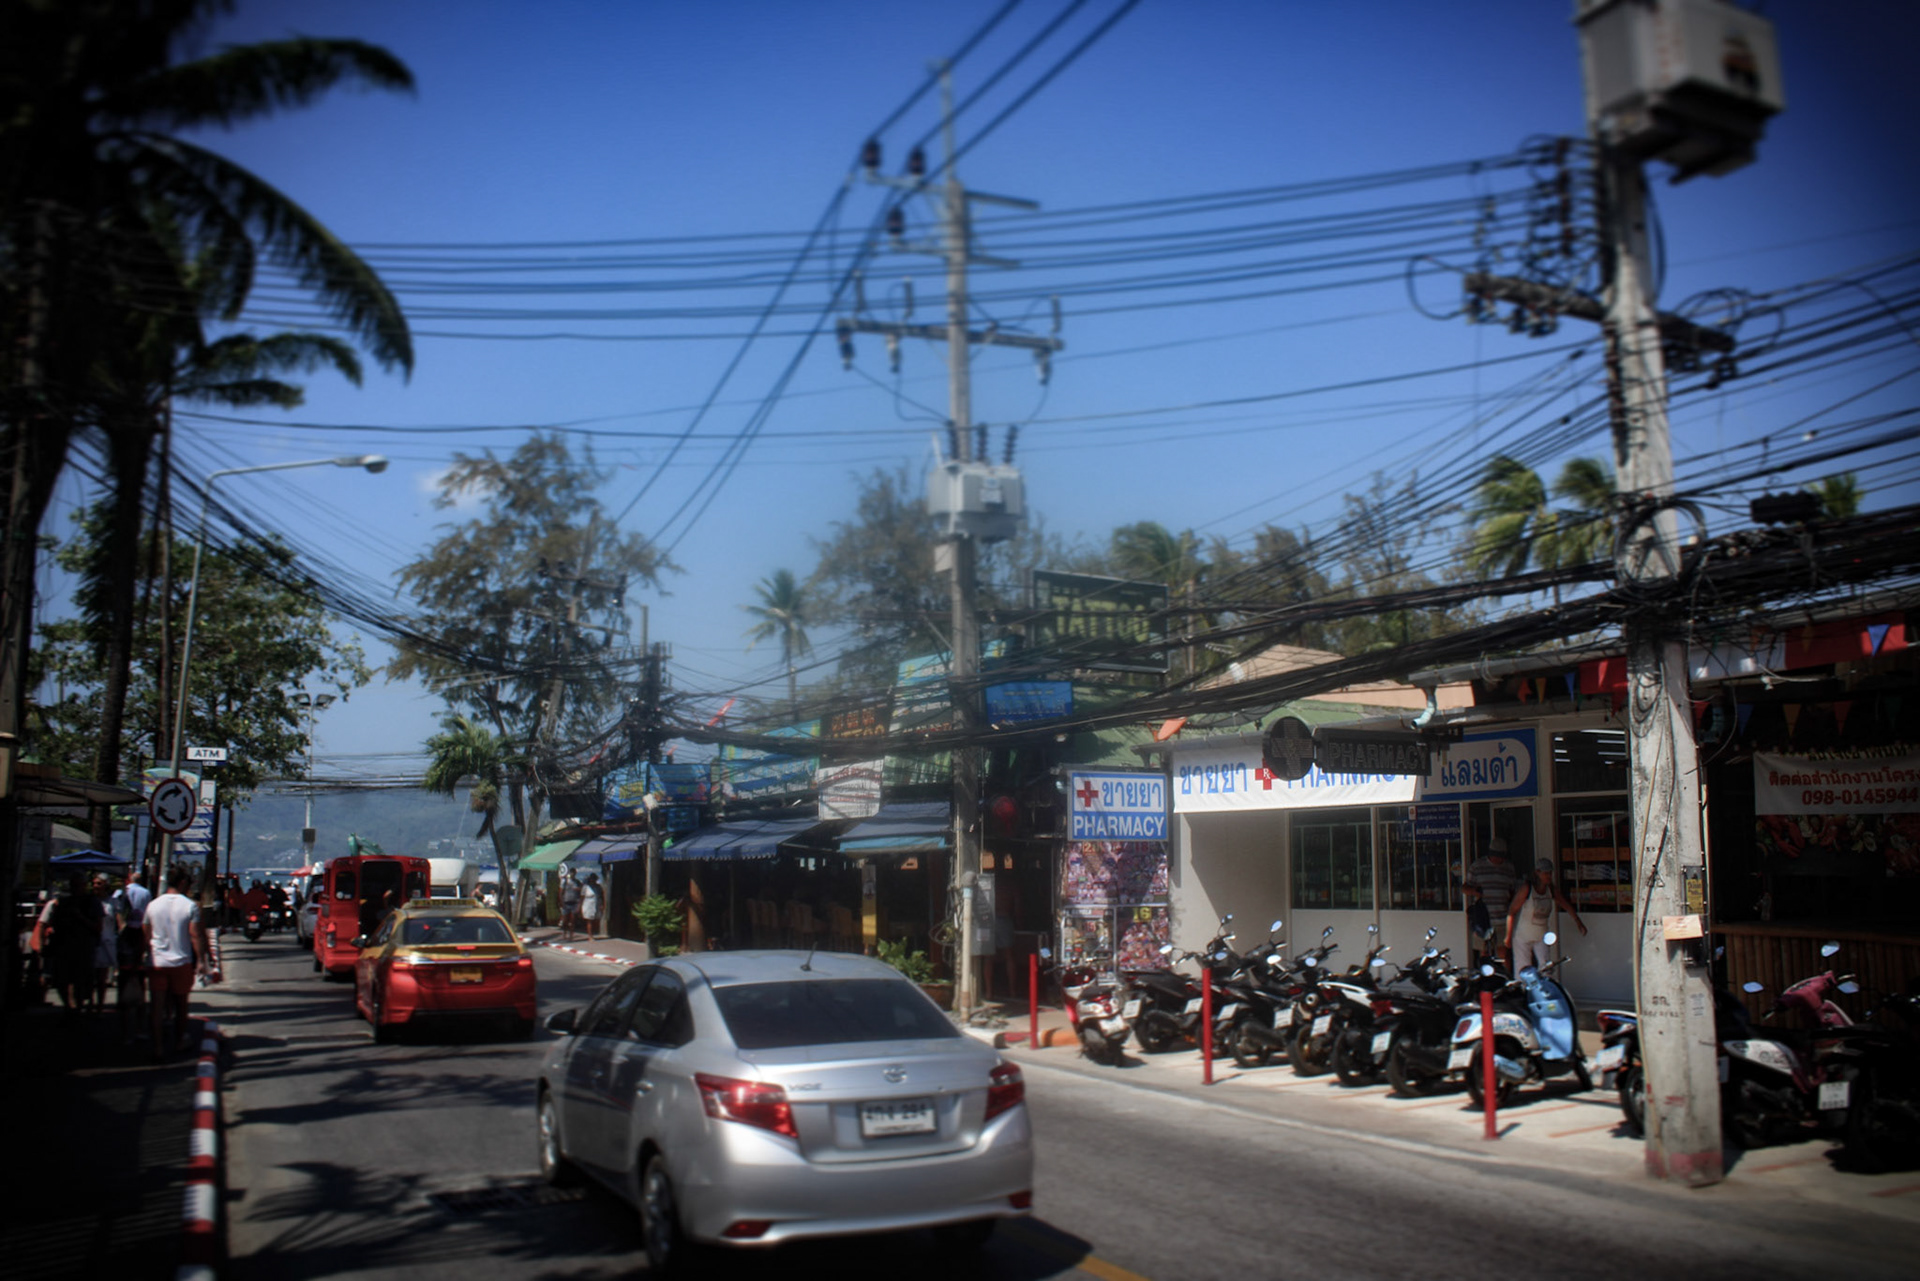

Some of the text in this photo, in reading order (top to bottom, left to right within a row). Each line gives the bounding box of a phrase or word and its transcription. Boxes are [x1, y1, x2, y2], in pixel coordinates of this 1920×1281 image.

[195, 749, 220, 758] ATM
[1328, 742, 1429, 770] PHARMACY
[1441, 742, 1518, 787] แลมด้า
[1179, 762, 1248, 795] ขายยา
[1102, 781, 1162, 807] ขายยา
[1801, 787, 1919, 806] 098-0145944
[1073, 815, 1165, 837] PHARMACY
